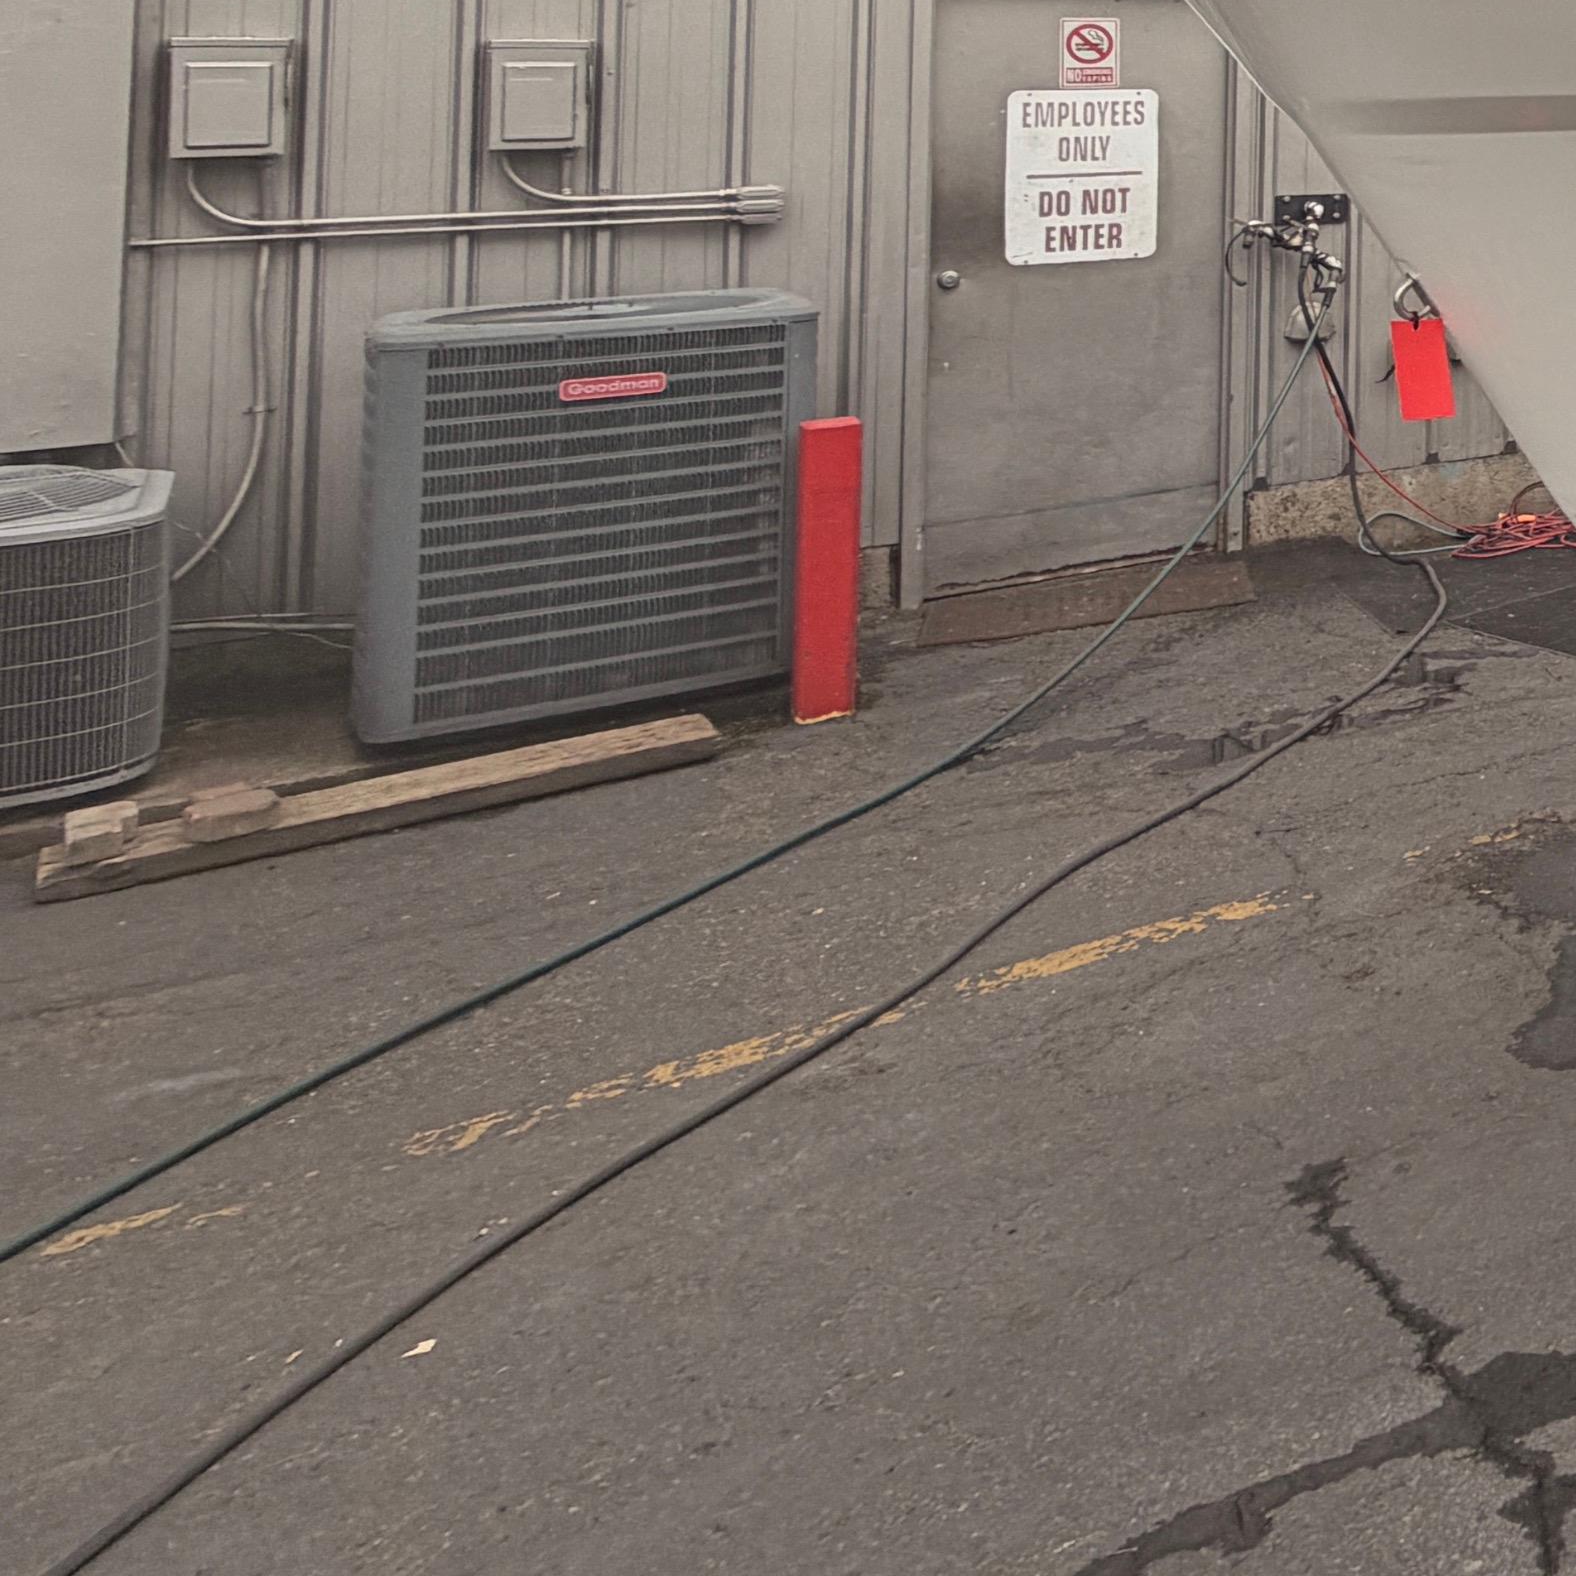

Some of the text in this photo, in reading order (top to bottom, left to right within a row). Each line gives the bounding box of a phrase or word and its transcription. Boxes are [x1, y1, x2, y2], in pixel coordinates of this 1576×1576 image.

[1067, 68, 1082, 83] NO
[1022, 100, 1145, 128] EMPLOYEES
[1058, 135, 1111, 162] ONLY
[1038, 187, 1131, 218] DO NOT
[1044, 222, 1123, 253] ENTER
[567, 378, 660, 395] Goodman
